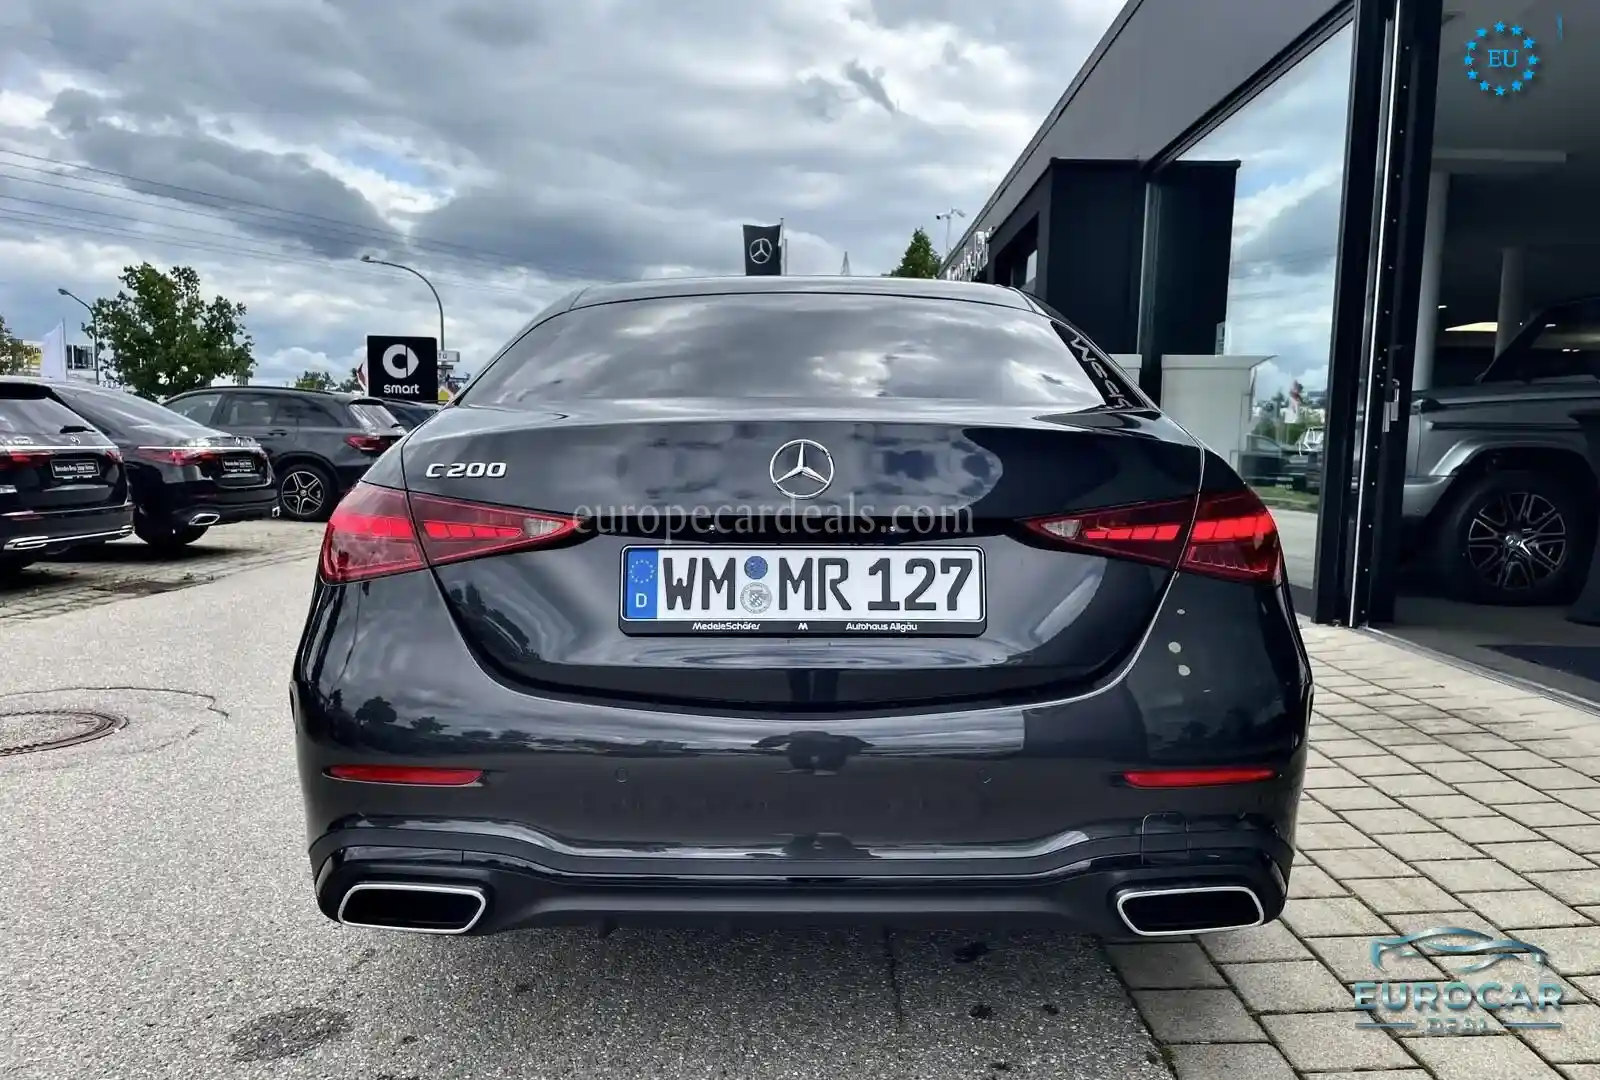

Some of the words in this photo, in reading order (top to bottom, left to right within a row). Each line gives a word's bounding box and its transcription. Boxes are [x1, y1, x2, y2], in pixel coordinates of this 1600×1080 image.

[383, 383, 420, 394] smart
[426, 463, 445, 477] C
[447, 462, 507, 477] 200
[663, 557, 737, 610] WM
[779, 557, 851, 610] MR
[868, 557, 973, 611] 127
[635, 593, 648, 608] D
[692, 621, 760, 630] MedeleSchäfer
[846, 622, 888, 631] Autohaus
[889, 622, 918, 633] Allgäu
